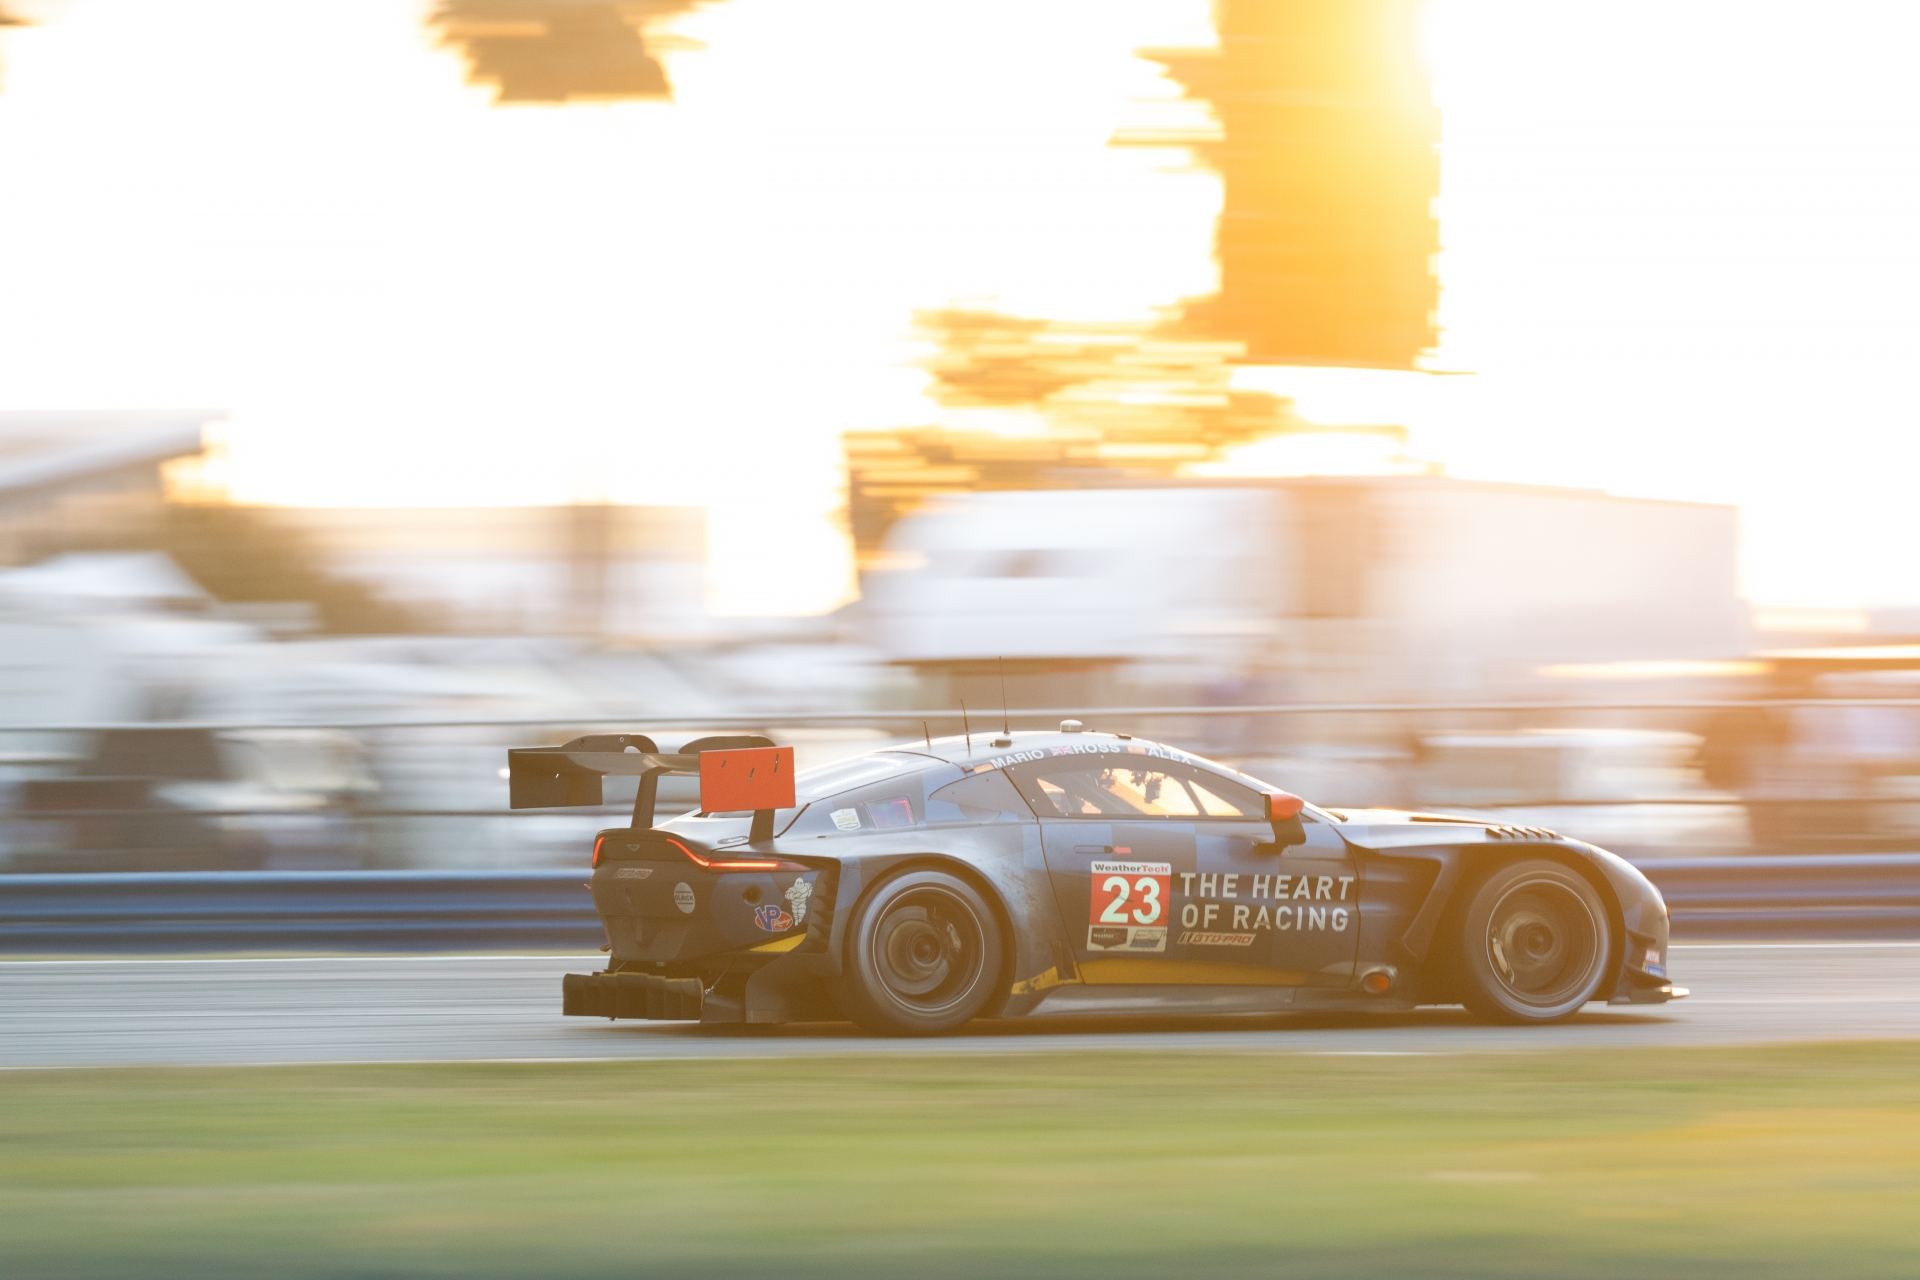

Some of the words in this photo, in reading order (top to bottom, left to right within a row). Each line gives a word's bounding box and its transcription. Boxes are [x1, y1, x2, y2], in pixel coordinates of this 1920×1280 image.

[989, 750, 1045, 769] MARIO
[1072, 742, 1121, 755] ROSS
[1147, 748, 1192, 765] ALEX
[1094, 863, 1168, 873] WeatherTech
[1180, 872, 1239, 898] THE
[1252, 874, 1354, 900] HEART
[1099, 876, 1162, 924] 23
[755, 905, 781, 931] VP
[1181, 903, 1220, 929] OF
[1232, 905, 1349, 932] RACING
